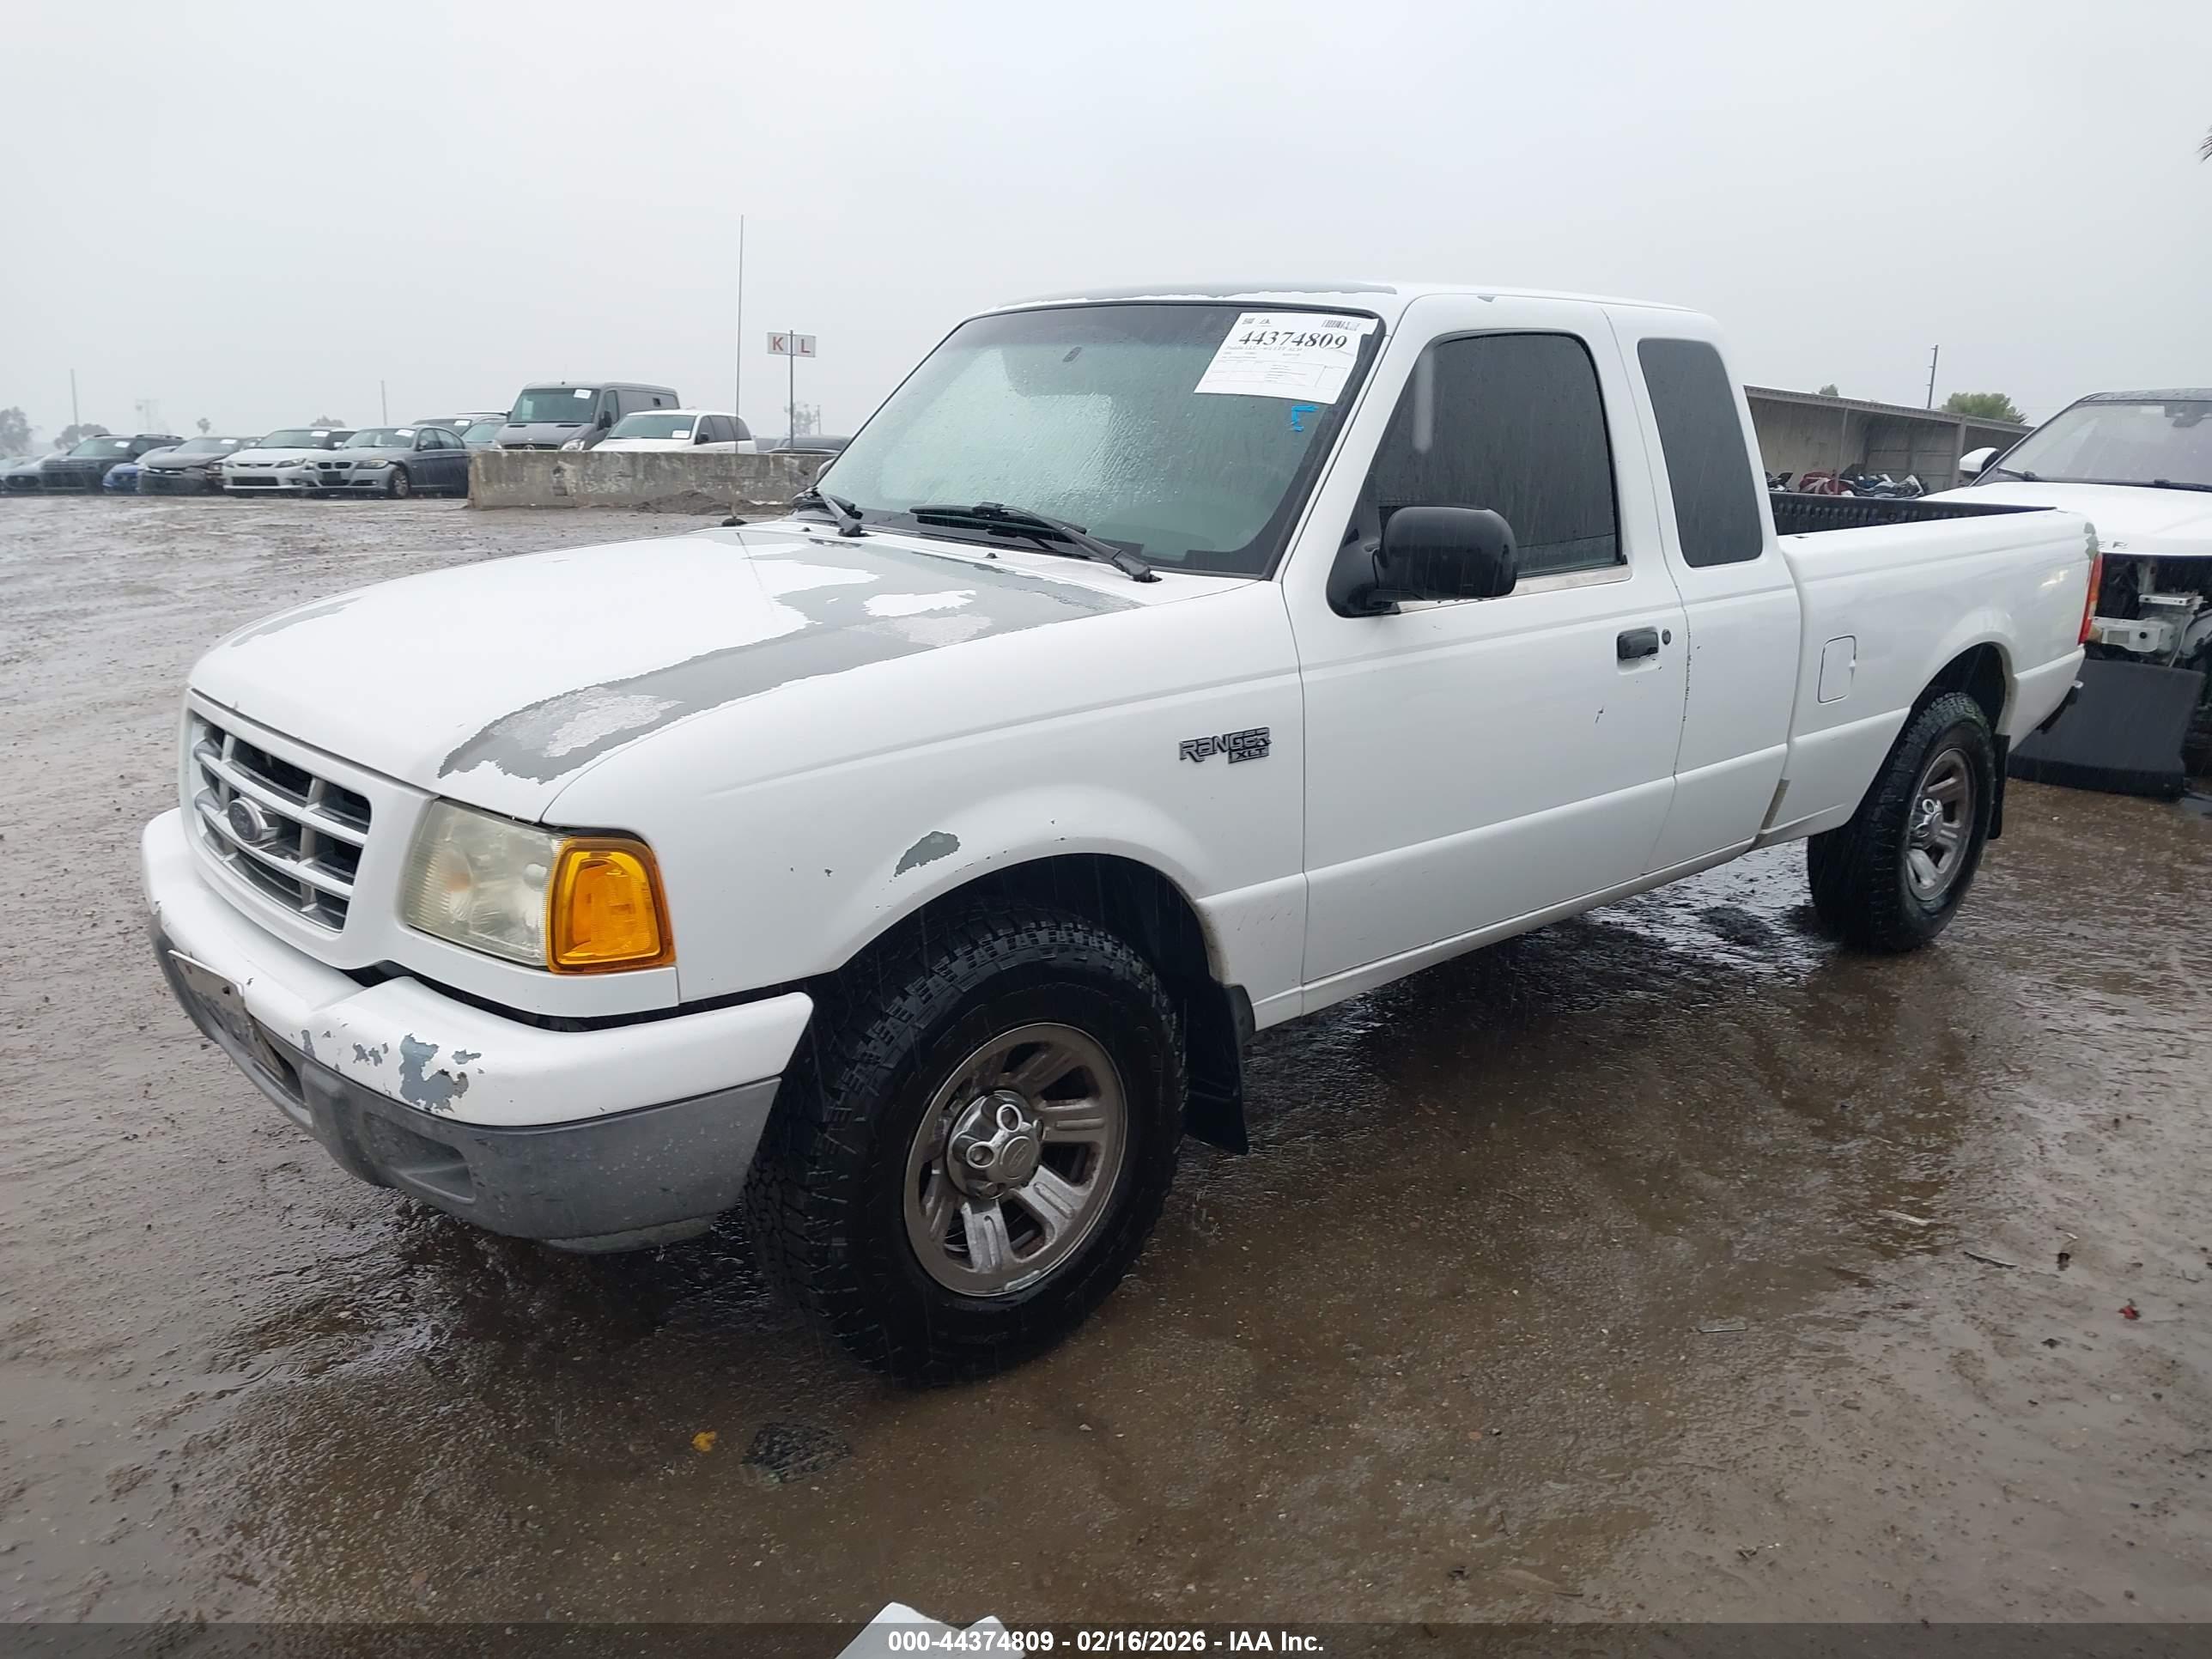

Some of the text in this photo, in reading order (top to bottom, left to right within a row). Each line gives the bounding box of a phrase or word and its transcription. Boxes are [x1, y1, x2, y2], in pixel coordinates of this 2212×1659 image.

[772, 336, 784, 351] K
[800, 338, 811, 353] L
[1238, 331, 1348, 349] 44374809
[1179, 726, 1272, 763] RANGER
[1234, 748, 1268, 762] XLT
